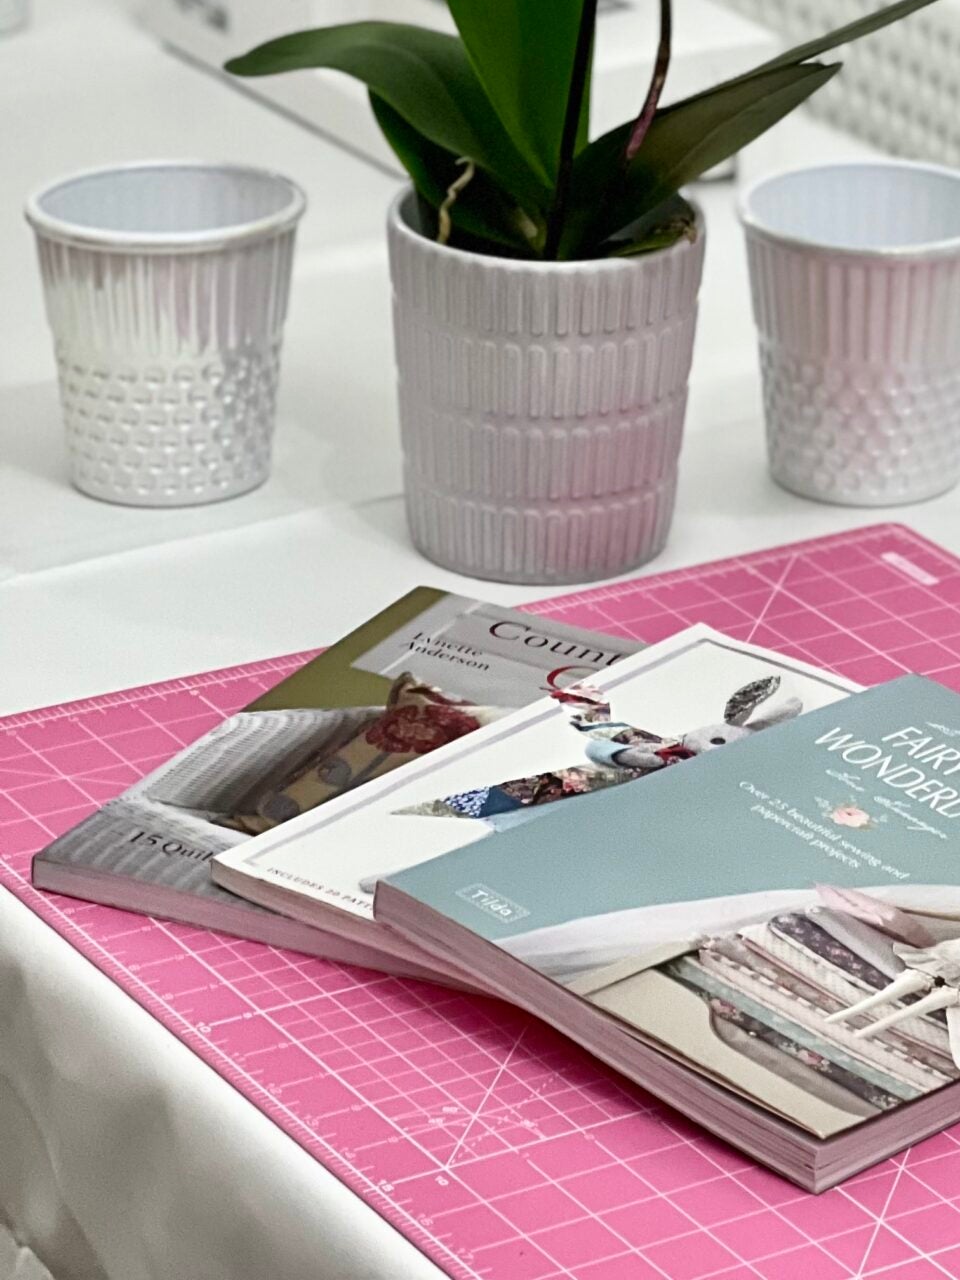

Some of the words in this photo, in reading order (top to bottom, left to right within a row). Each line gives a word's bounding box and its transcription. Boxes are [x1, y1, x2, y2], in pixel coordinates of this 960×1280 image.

[405, 641, 490, 671] Anderson
[412, 632, 483, 657] Lynette
[130, 831, 163, 846] 15
[739, 780, 770, 801] Over
[768, 798, 789, 811] 25
[787, 808, 842, 841] beautiful
[840, 839, 882, 867] sewing
[881, 864, 911, 880] and
[751, 804, 814, 841] papercraft
[809, 838, 860, 869] projects
[267, 867, 324, 890] INCLUDES
[341, 894, 373, 911] PATT
[471, 889, 513, 916] Tilda
